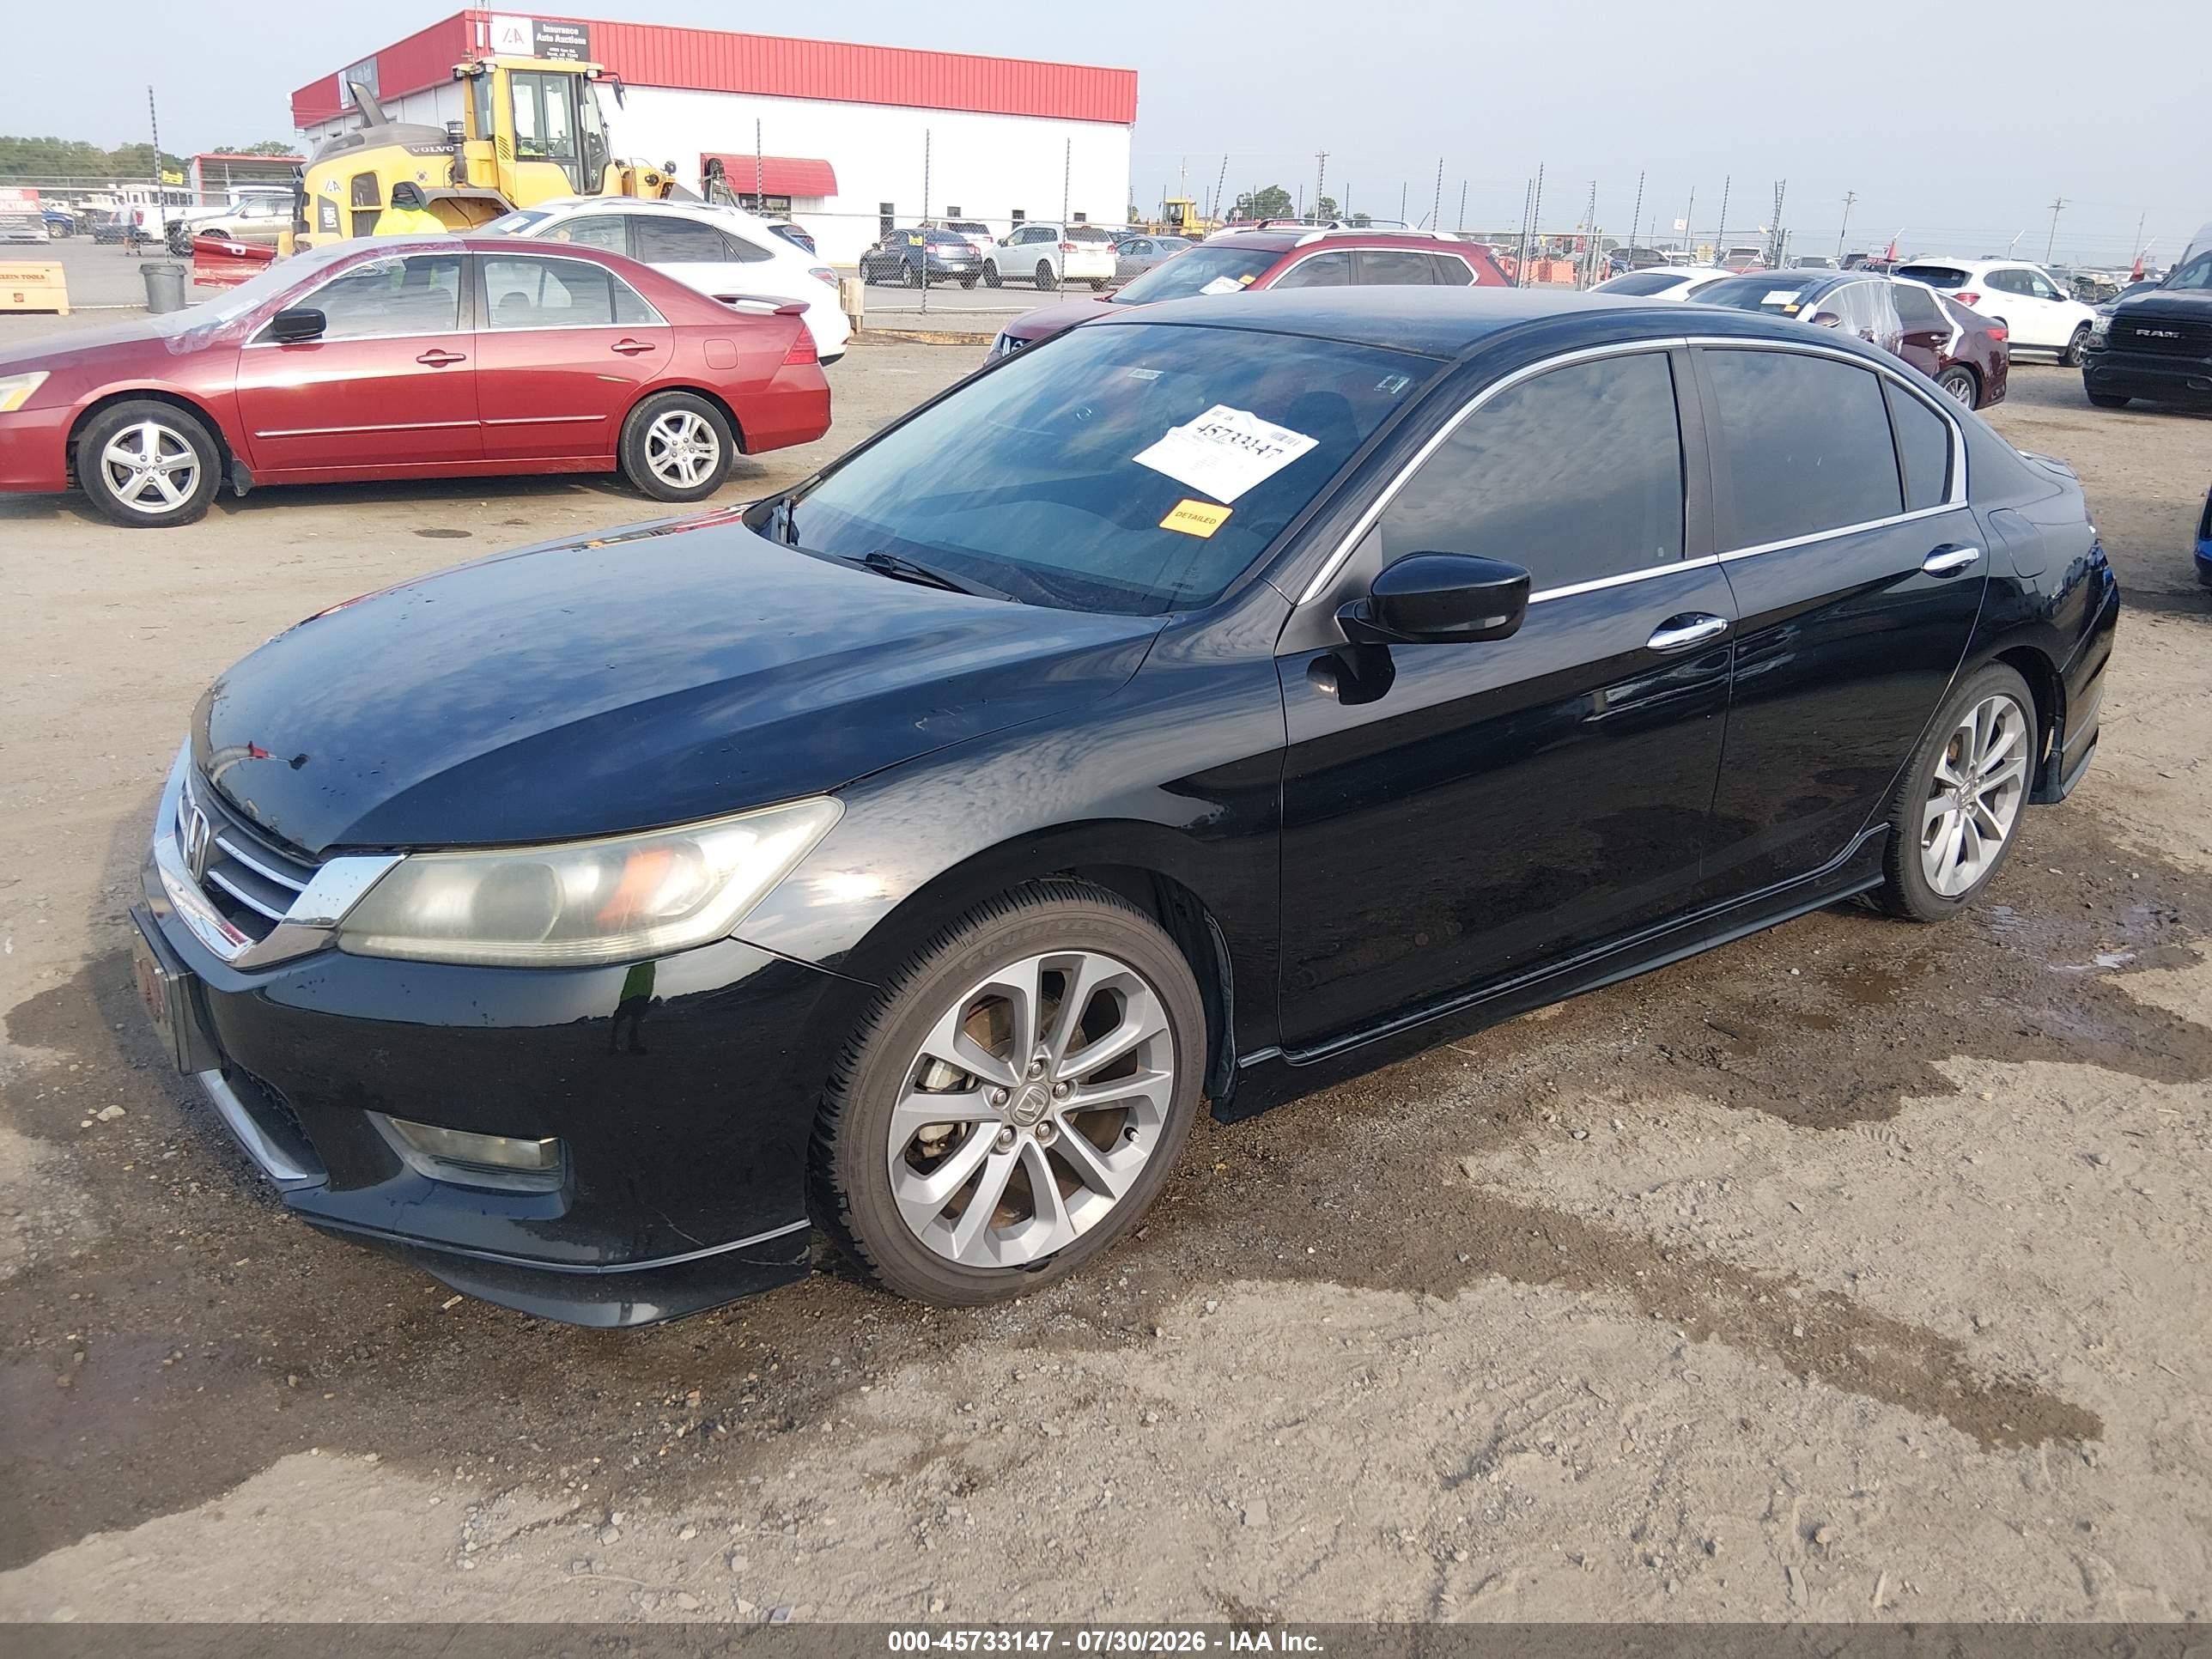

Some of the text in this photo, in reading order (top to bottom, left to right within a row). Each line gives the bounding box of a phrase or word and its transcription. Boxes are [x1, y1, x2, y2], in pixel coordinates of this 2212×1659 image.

[542, 24, 580, 35] Insurance
[536, 33, 587, 46] Auto Auctions
[2136, 329, 2180, 339] RAM
[1175, 510, 1217, 526] DETAILED
